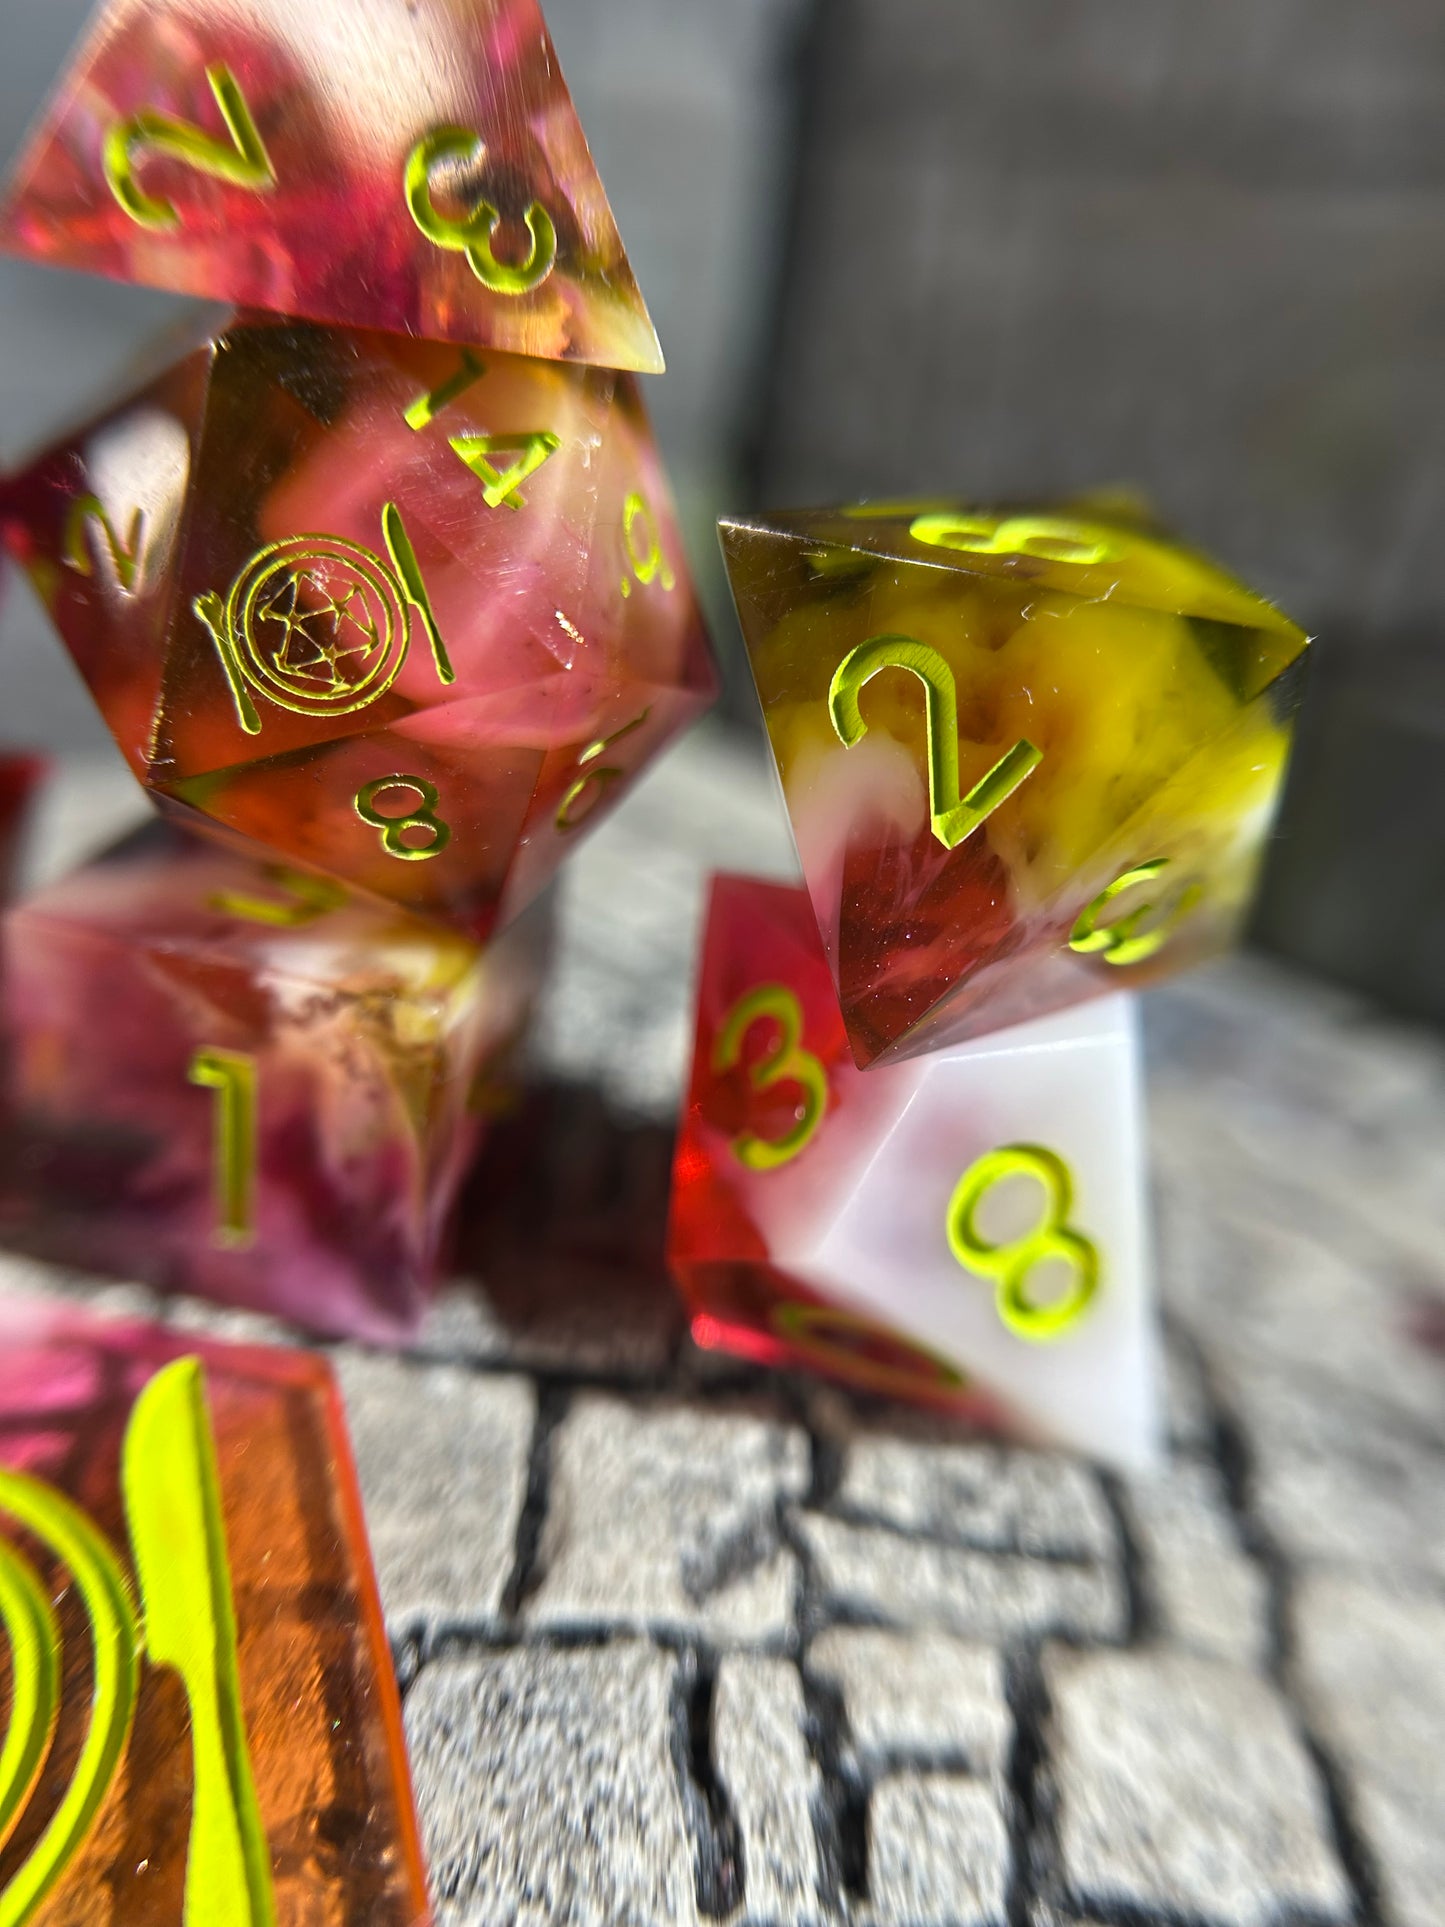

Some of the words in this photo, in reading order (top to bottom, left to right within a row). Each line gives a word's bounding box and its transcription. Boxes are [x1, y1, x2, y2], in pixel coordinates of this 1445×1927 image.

[103, 62, 277, 233] 2
[404, 125, 557, 295] 3
[355, 774, 451, 862] 8
[828, 633, 1043, 850] 2
[187, 1045, 257, 1251] 1
[712, 983, 829, 1171] 3
[945, 1141, 1104, 1343] 8
